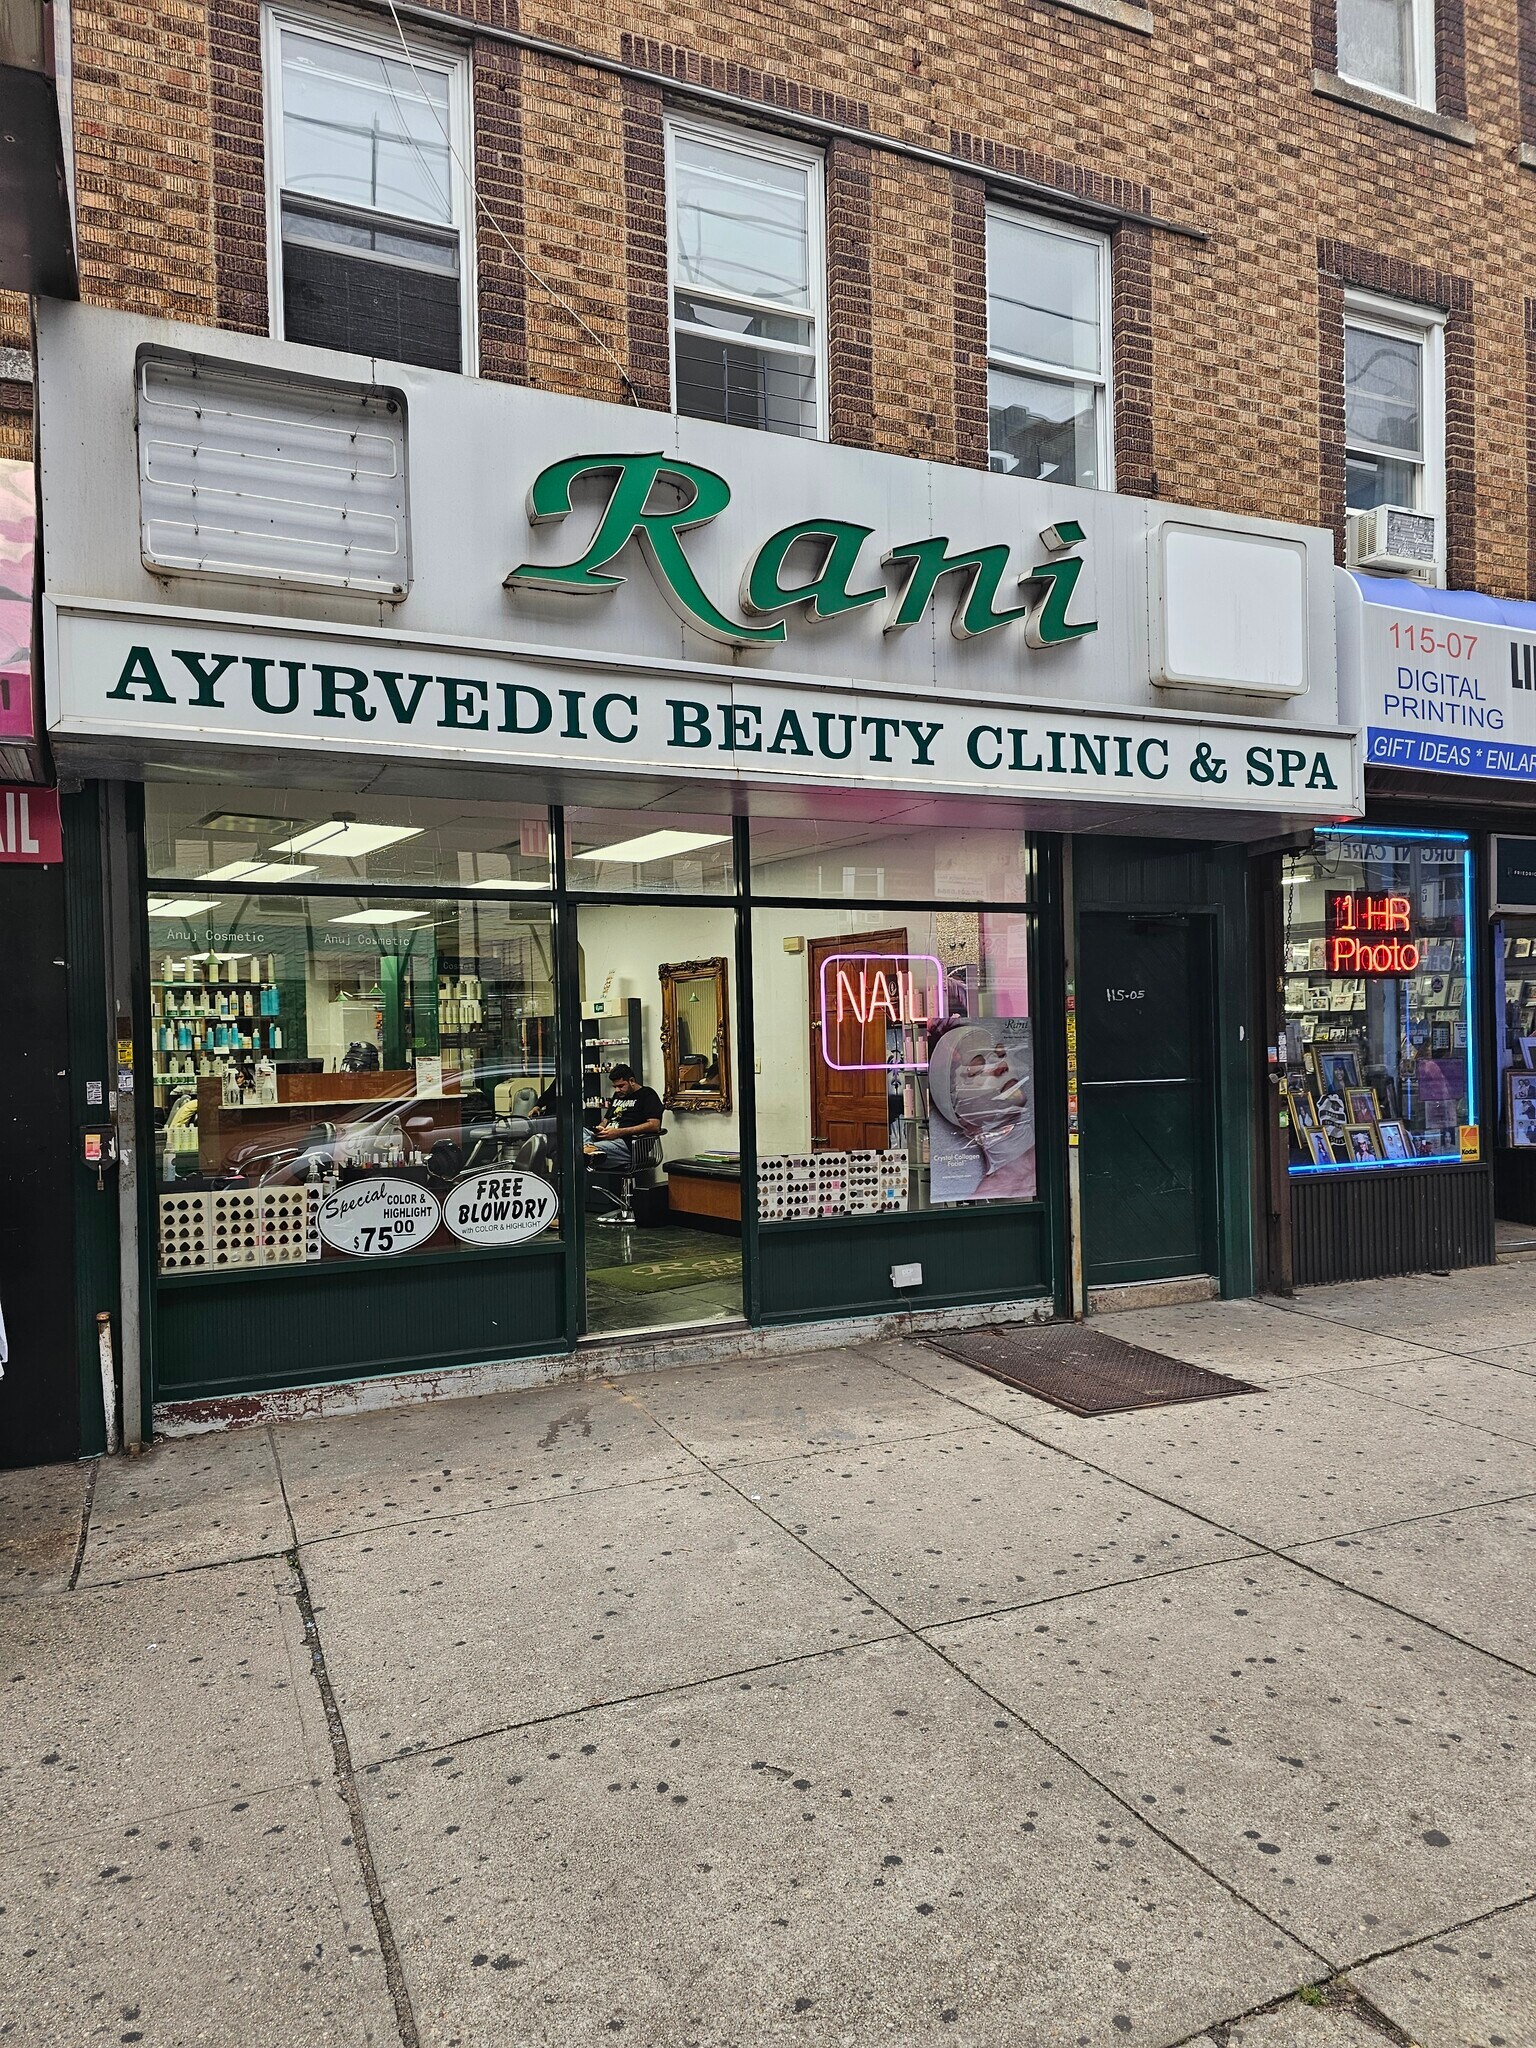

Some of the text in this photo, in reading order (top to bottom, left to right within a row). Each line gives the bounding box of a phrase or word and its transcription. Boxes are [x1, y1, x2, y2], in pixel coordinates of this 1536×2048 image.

[504, 451, 1098, 650] Rani
[1389, 622, 1478, 660] 115-07
[1397, 666, 1487, 701] DIGITAL
[1510, 641, 1536, 691] LI
[105, 645, 1338, 791] AYURVEDIC BEAUTY CLINIC & SPA
[1384, 693, 1504, 730] PRINTING
[1373, 735, 1416, 759] GIFT
[1418, 741, 1471, 767] IDEAS
[0, 791, 39, 854] IL
[1341, 895, 1411, 932] 1 HR
[166, 928, 265, 943] Anuj Cosmetic
[324, 932, 410, 947] Anuj Cosmetic
[1333, 937, 1420, 972] Photo
[836, 969, 929, 1024] NAIL
[954, 1153, 980, 1161] Collagen
[1461, 1148, 1479, 1156] Kodak
[325, 1182, 388, 1220] Special
[387, 1193, 427, 1205] COLOR &
[476, 1177, 524, 1201] FREE
[383, 1206, 433, 1219] HIGHLIGHT
[458, 1197, 548, 1225] BLOWDRY
[461, 1220, 541, 1234] with COLOR & HIGHLIGHT
